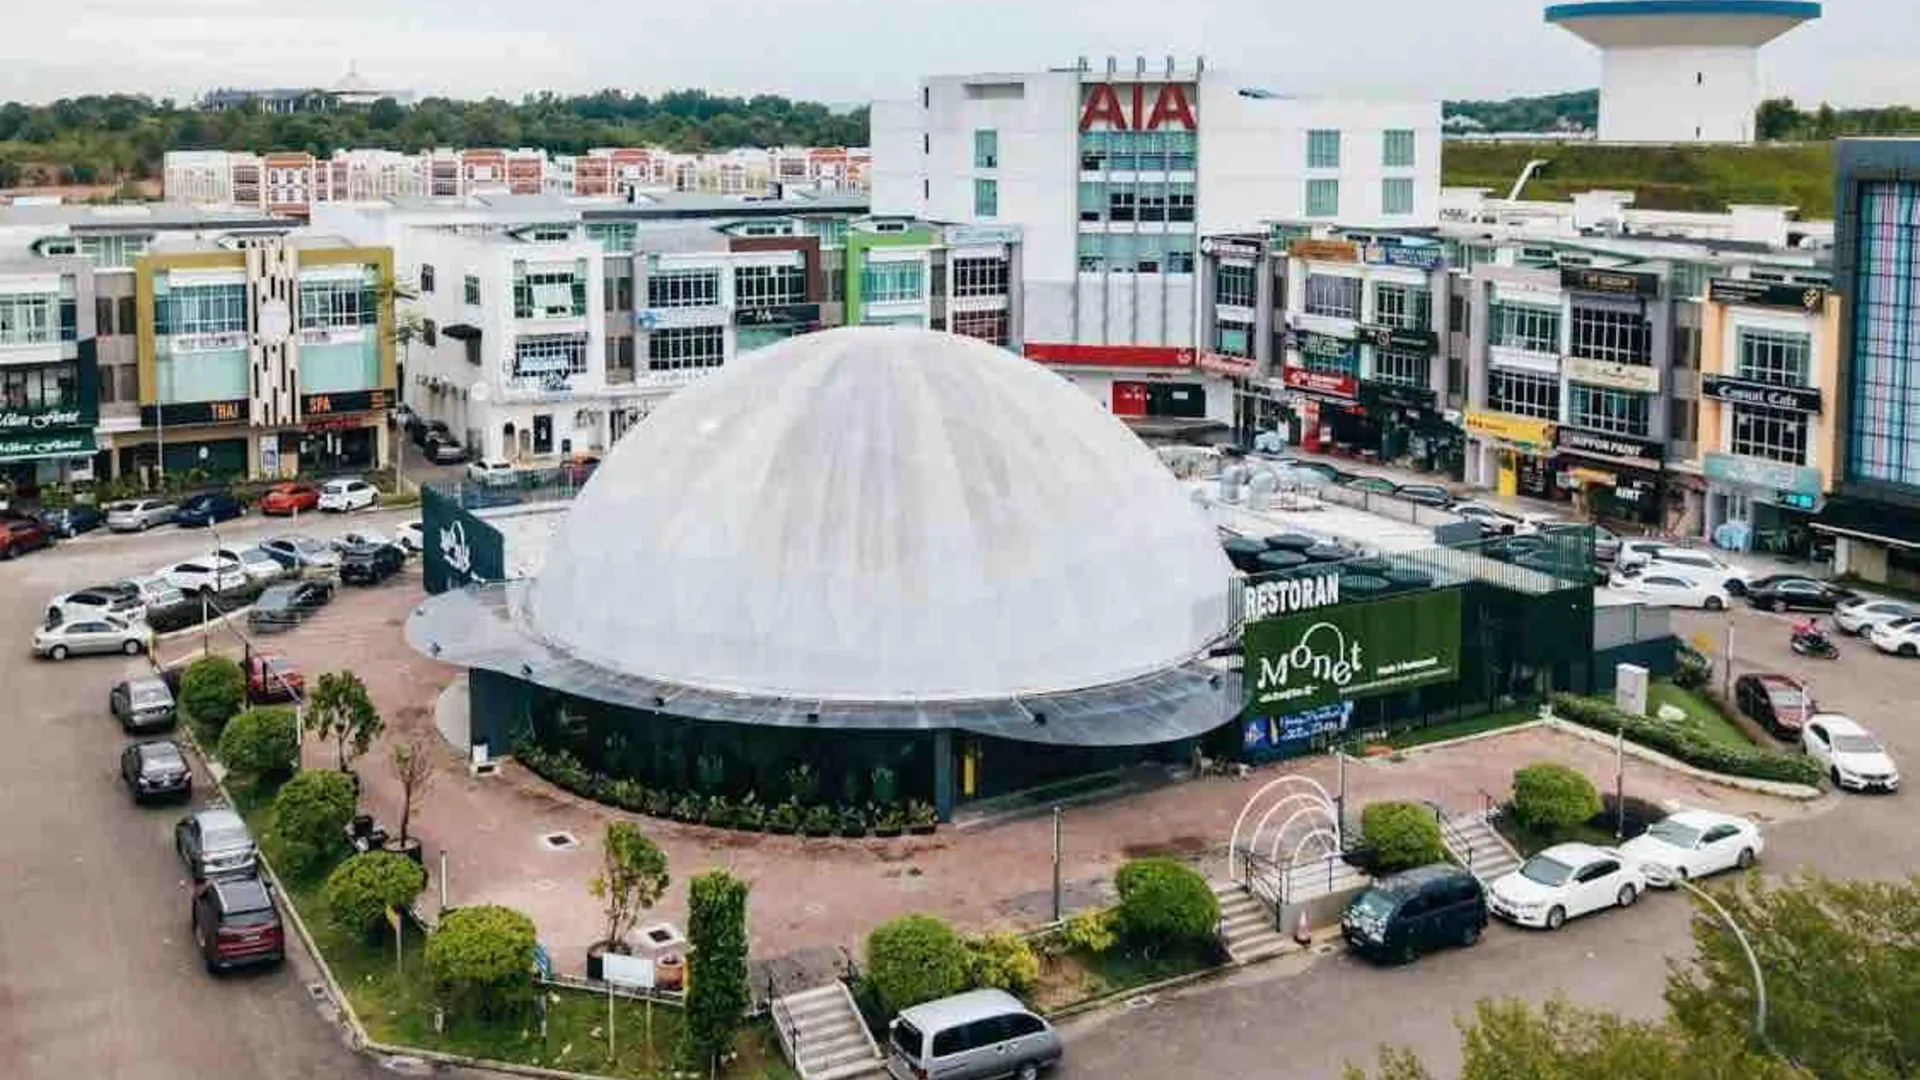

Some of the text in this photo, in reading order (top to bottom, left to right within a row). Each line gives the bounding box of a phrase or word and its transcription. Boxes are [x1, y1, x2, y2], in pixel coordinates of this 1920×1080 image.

[1080, 83, 1197, 130] AIA
[1244, 572, 1339, 624] RESTORAN
[1257, 622, 1362, 689] Monet
